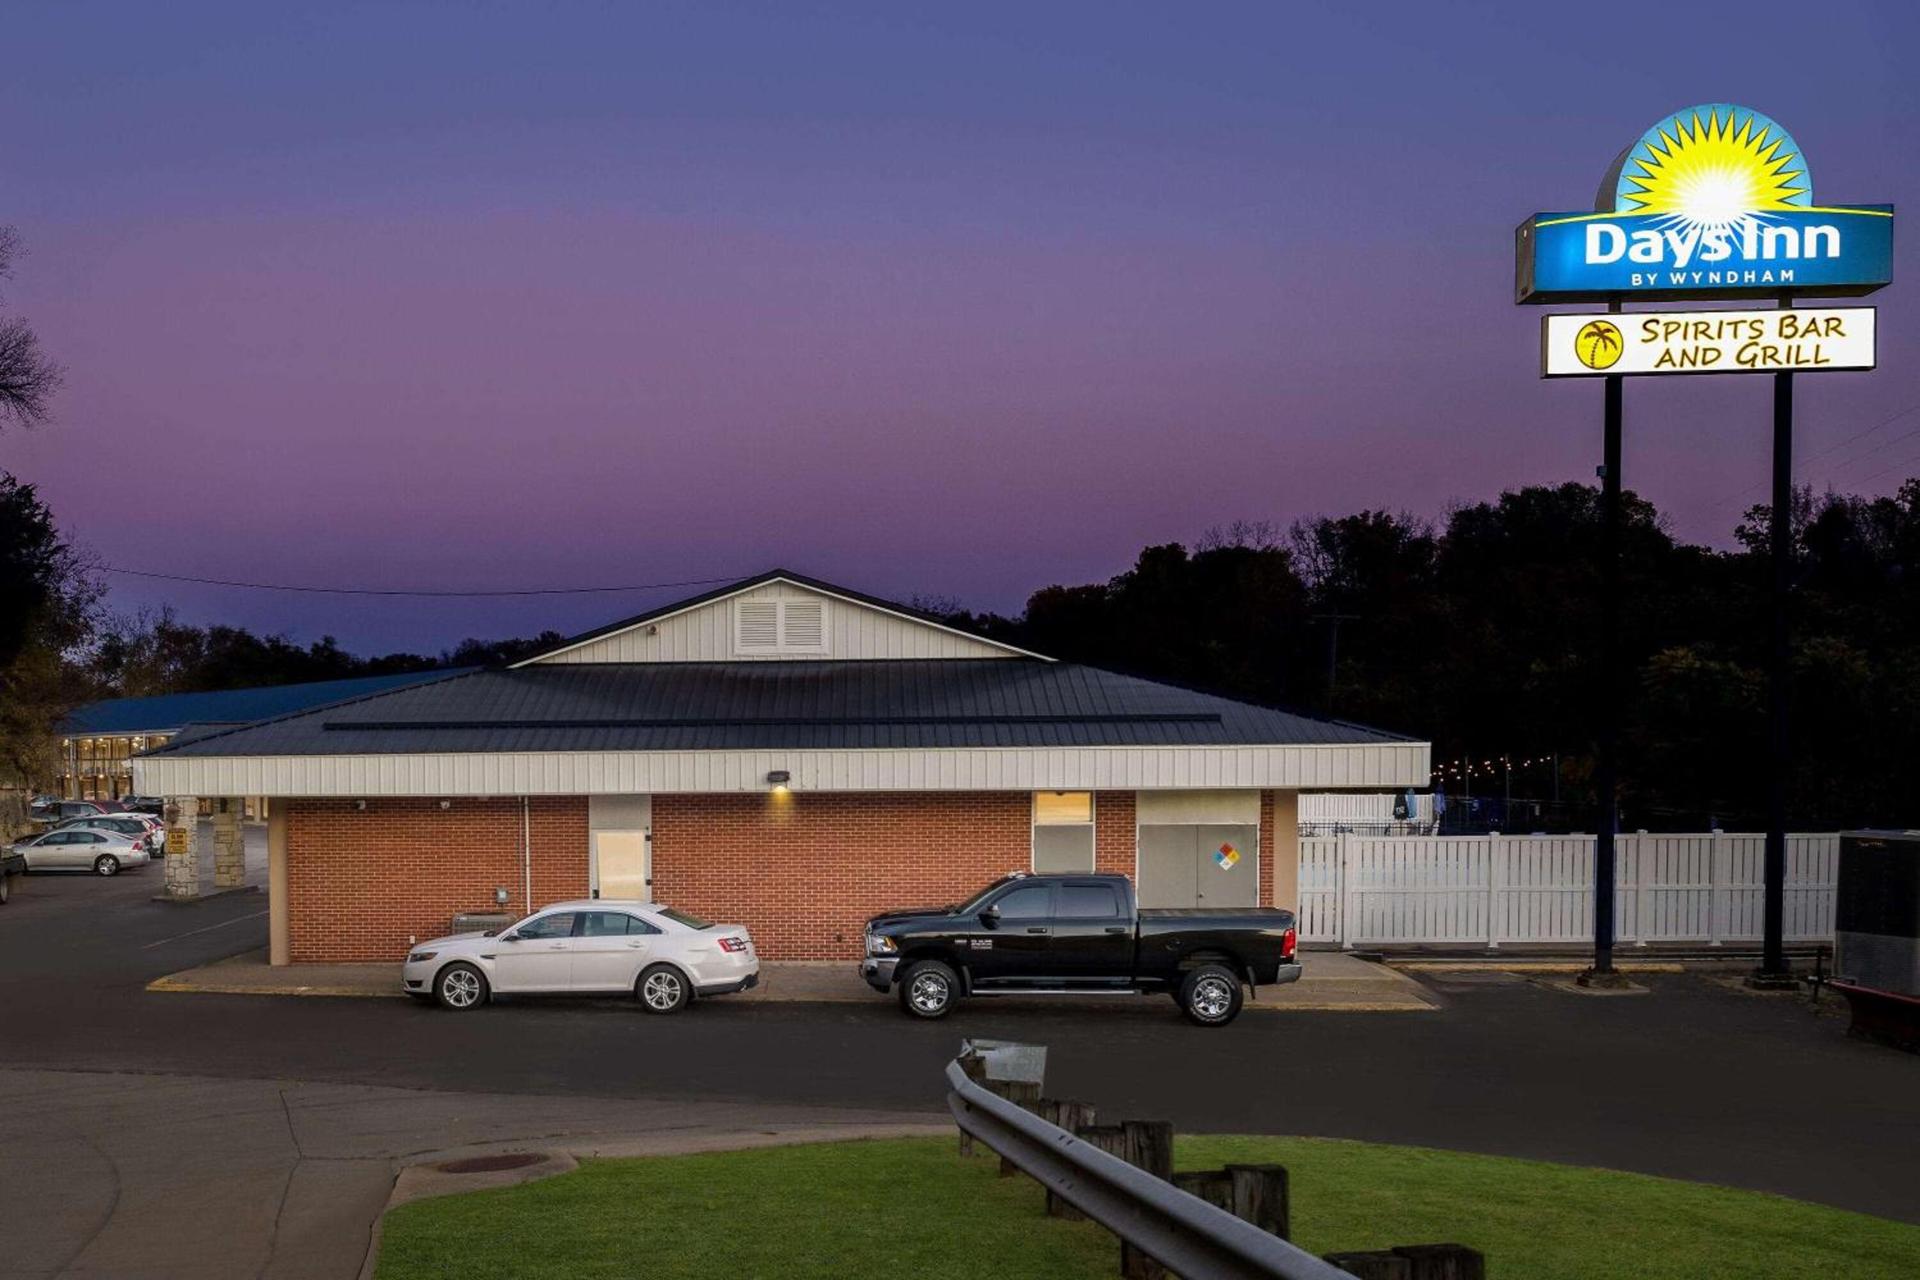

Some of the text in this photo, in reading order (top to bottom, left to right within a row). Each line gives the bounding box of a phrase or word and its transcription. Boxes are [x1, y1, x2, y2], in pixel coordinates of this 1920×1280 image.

[1585, 218, 1841, 268] Days Inn
[1631, 269, 1795, 286] BY WYNDHAM
[1641, 314, 1846, 343] SPIRITS BAR
[1654, 341, 1830, 368] AND GRILL
